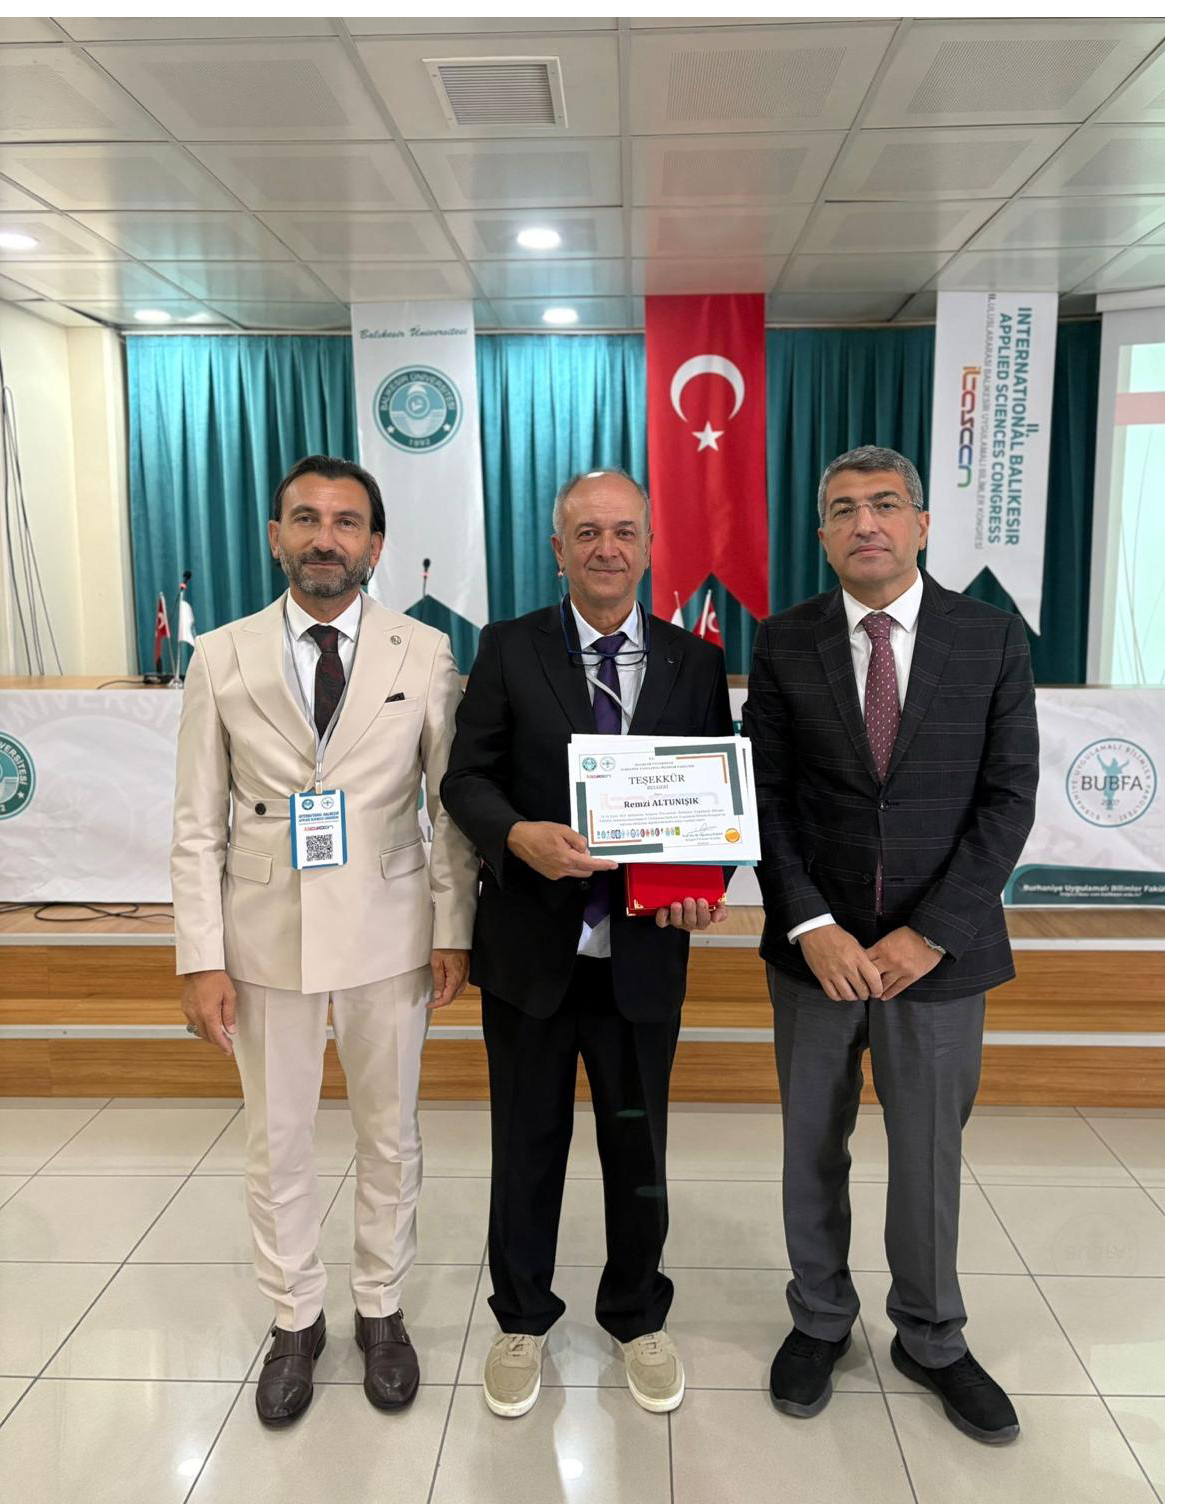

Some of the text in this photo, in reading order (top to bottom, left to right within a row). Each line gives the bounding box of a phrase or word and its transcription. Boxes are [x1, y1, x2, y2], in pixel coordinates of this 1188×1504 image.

[409, 325, 468, 337] Üniversitesi
[988, 313, 1012, 543] APPLIED SCIENCES CONGRESS
[1005, 307, 1032, 545] INTERNATIONAL BALIKESIR
[1026, 424, 1039, 437] II.
[628, 774, 685, 786] TEŞEKKÜR
[1081, 775, 1143, 791] BUBFA
[624, 797, 699, 808] Remzi ALTUNIŞIK
